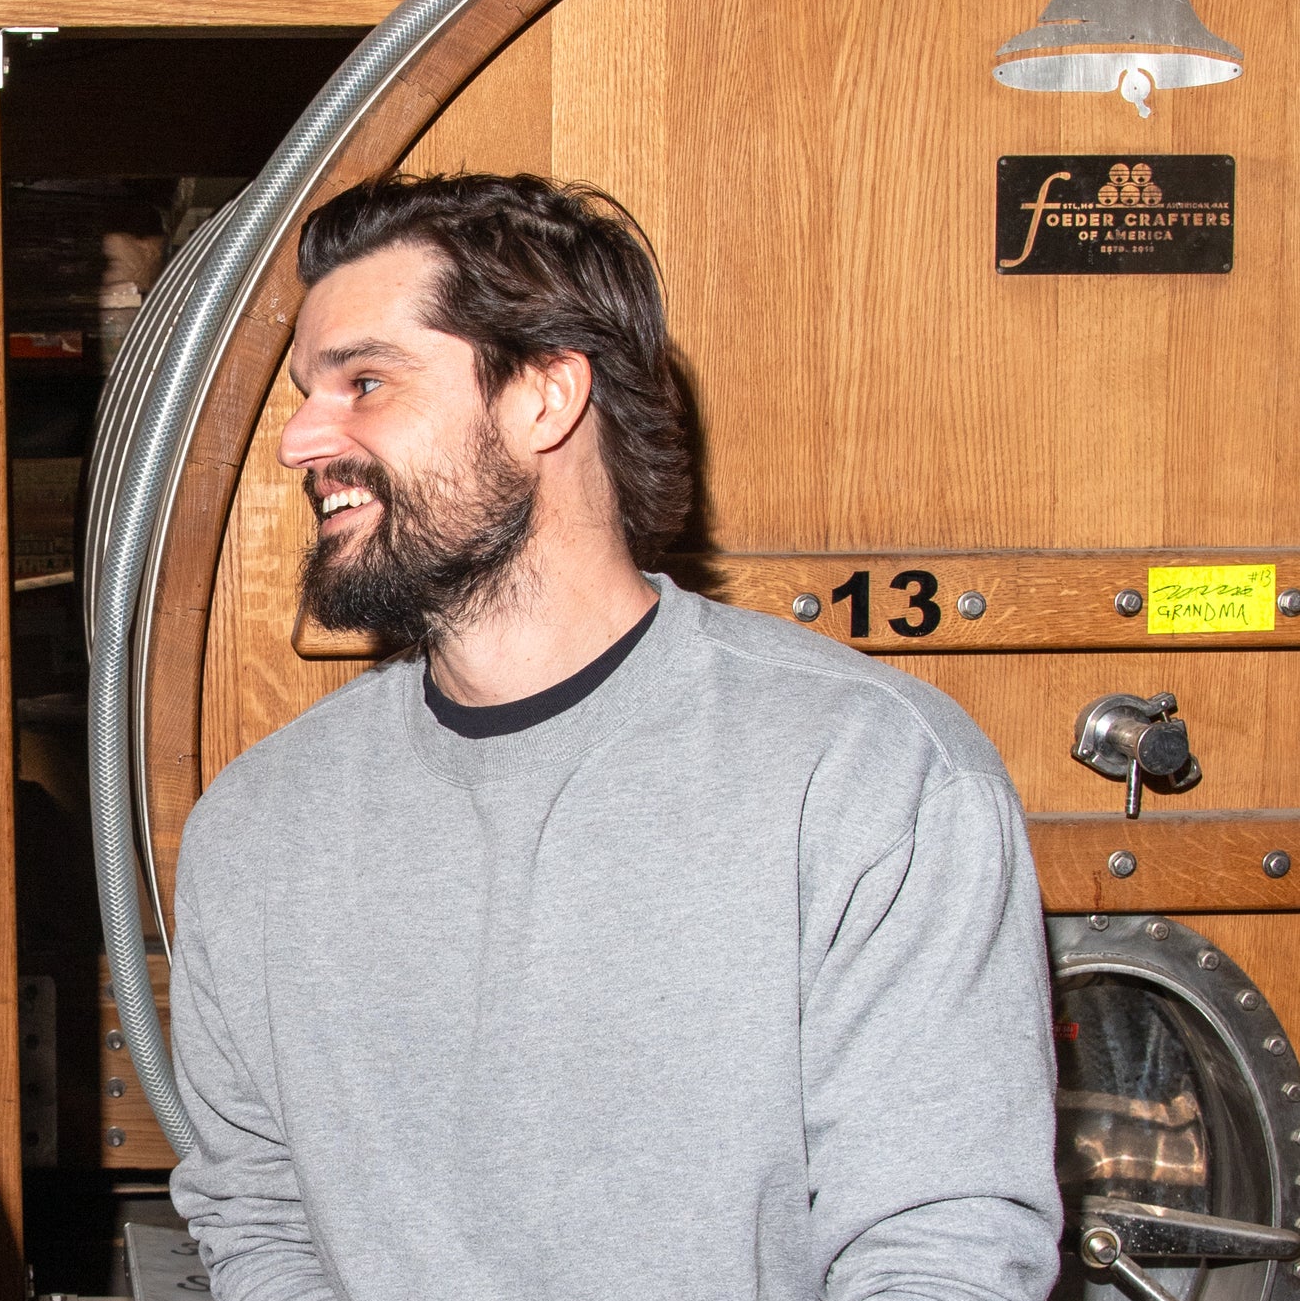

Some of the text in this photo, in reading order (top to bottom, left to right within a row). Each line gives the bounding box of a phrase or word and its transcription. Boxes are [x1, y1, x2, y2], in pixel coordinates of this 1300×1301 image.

[1124, 211, 1231, 227] CRAFTERS
[1078, 230, 1173, 241] OF AMERICA
[1247, 569, 1272, 587] #13
[831, 570, 942, 639] 13
[1157, 602, 1249, 626] GRANDMA
